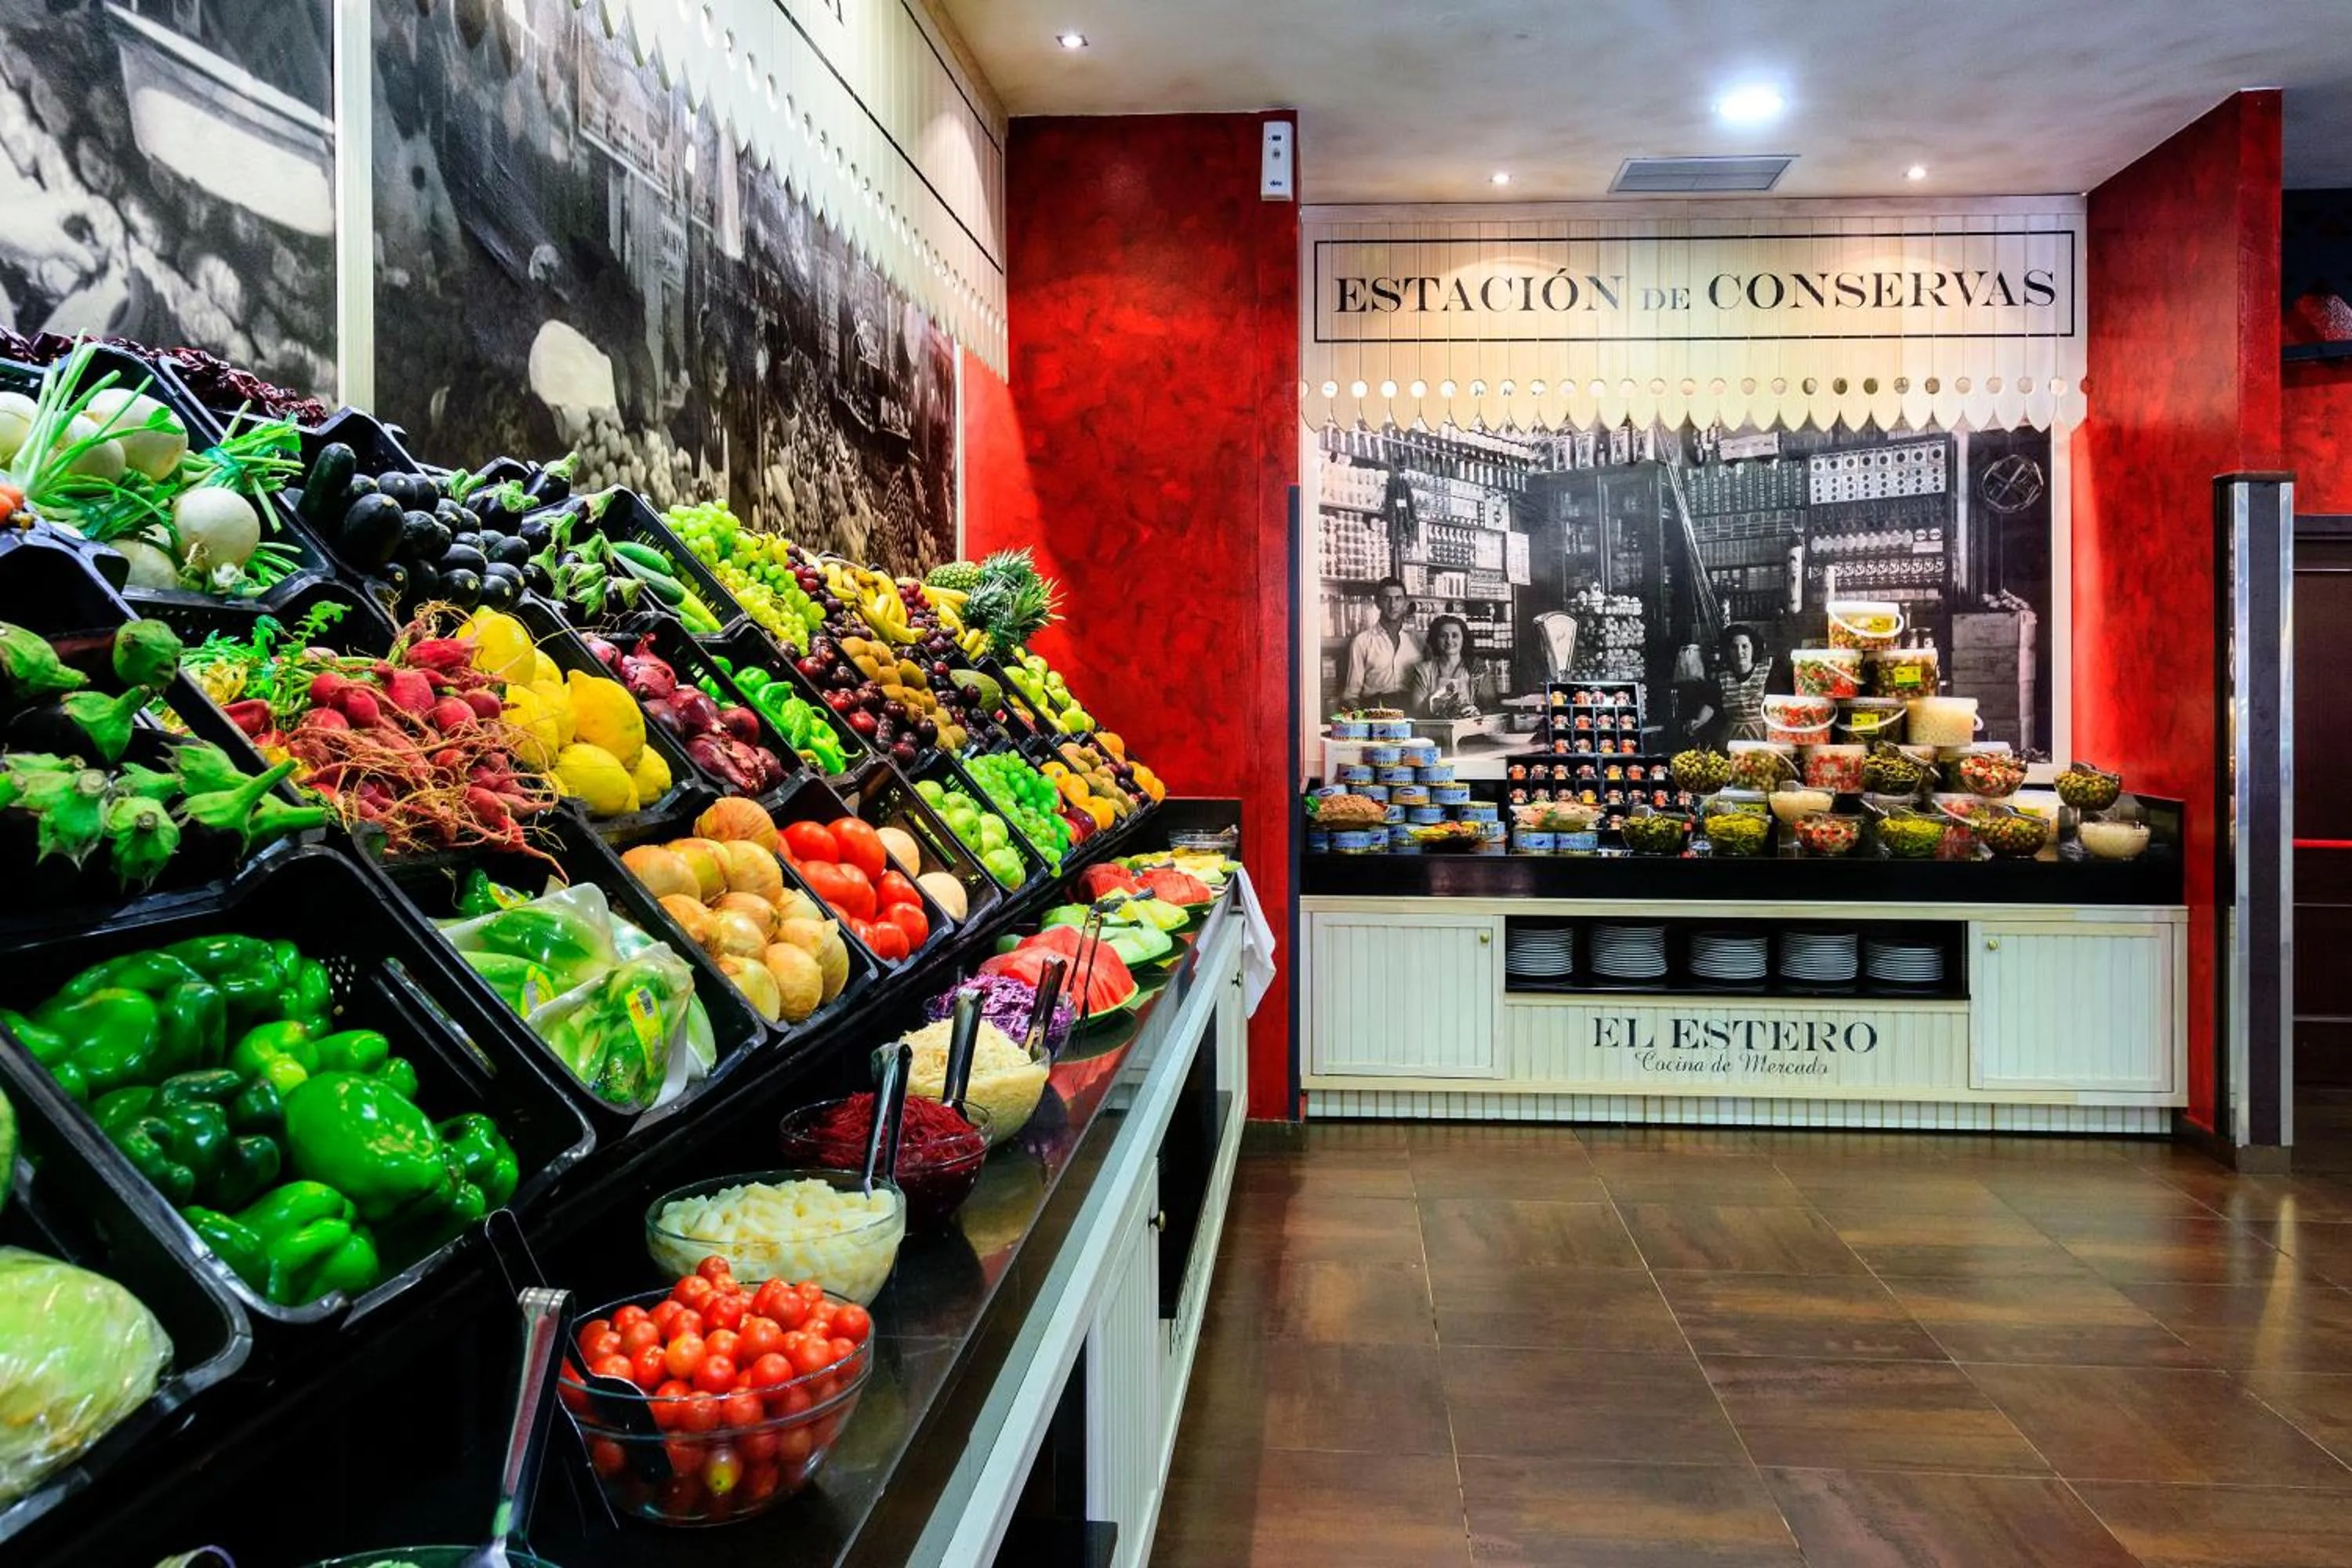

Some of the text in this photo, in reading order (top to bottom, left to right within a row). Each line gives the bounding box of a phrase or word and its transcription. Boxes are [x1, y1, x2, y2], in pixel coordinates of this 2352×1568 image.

[1334, 268, 2057, 314] ESTACIÓN DE CONSERVAS
[1594, 1017, 1878, 1054] EL ESTERO
[1635, 1051, 1704, 1073] Cocina
[1711, 1054, 1731, 1073] de
